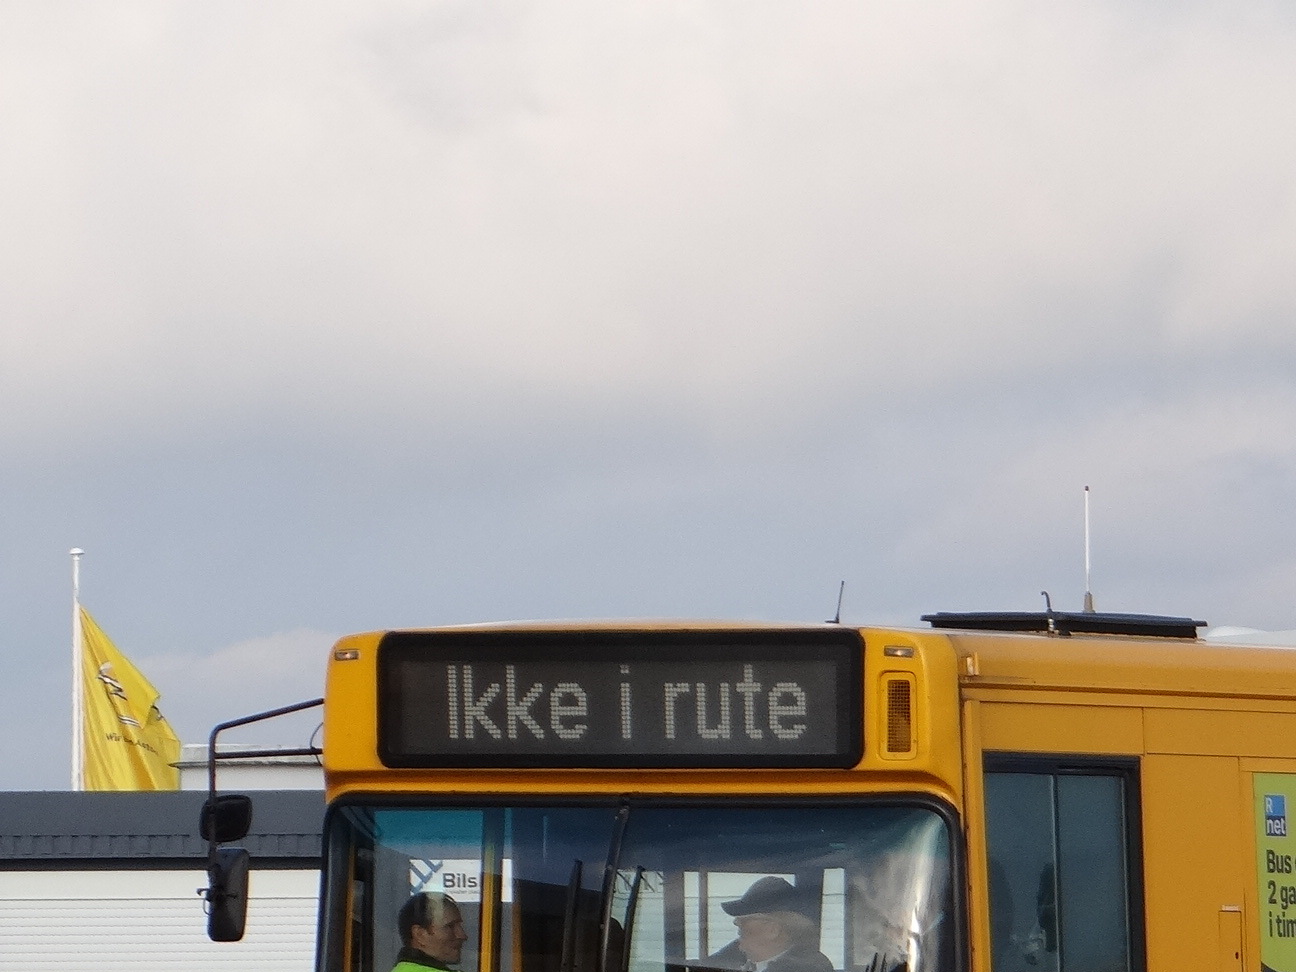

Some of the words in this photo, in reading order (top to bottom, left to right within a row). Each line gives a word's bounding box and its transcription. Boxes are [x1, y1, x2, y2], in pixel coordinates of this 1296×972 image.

[446, 663, 589, 741] Ikke
[619, 663, 633, 741] i
[663, 663, 808, 741] rute
[1264, 796, 1274, 814] R
[1265, 816, 1287, 836] net
[1265, 849, 1293, 875] Bus
[1267, 879, 1278, 905] 2
[1268, 910, 1274, 938] i
